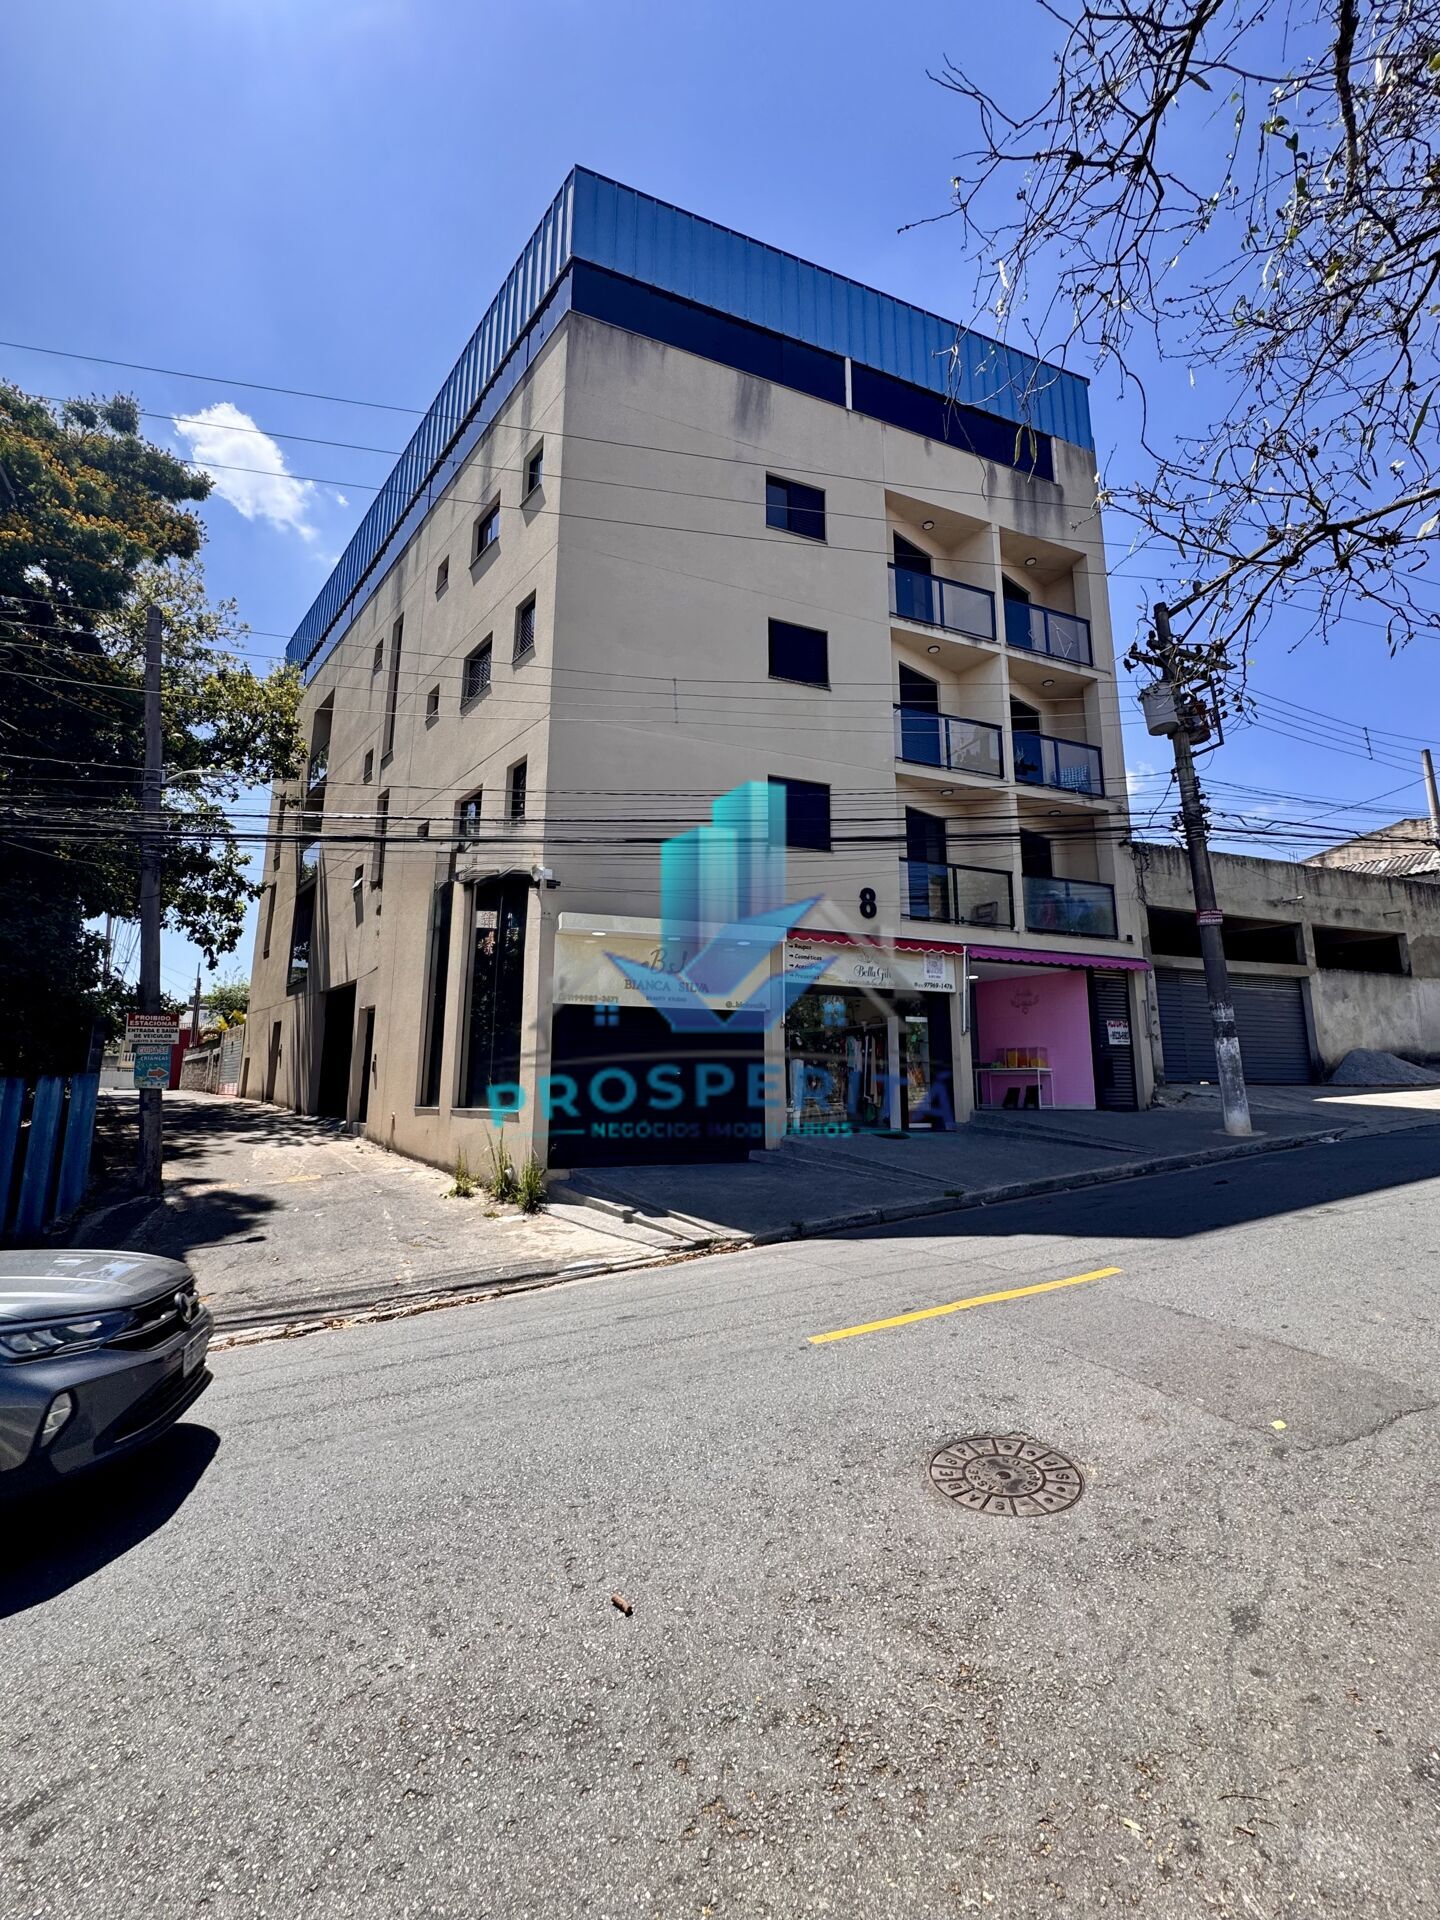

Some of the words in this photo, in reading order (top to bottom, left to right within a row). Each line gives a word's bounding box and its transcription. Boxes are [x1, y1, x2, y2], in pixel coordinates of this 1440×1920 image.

[859, 886, 878, 920] 8
[853, 964, 876, 978] Bella
[623, 978, 671, 992] BIANCA
[678, 981, 710, 993] SILVA
